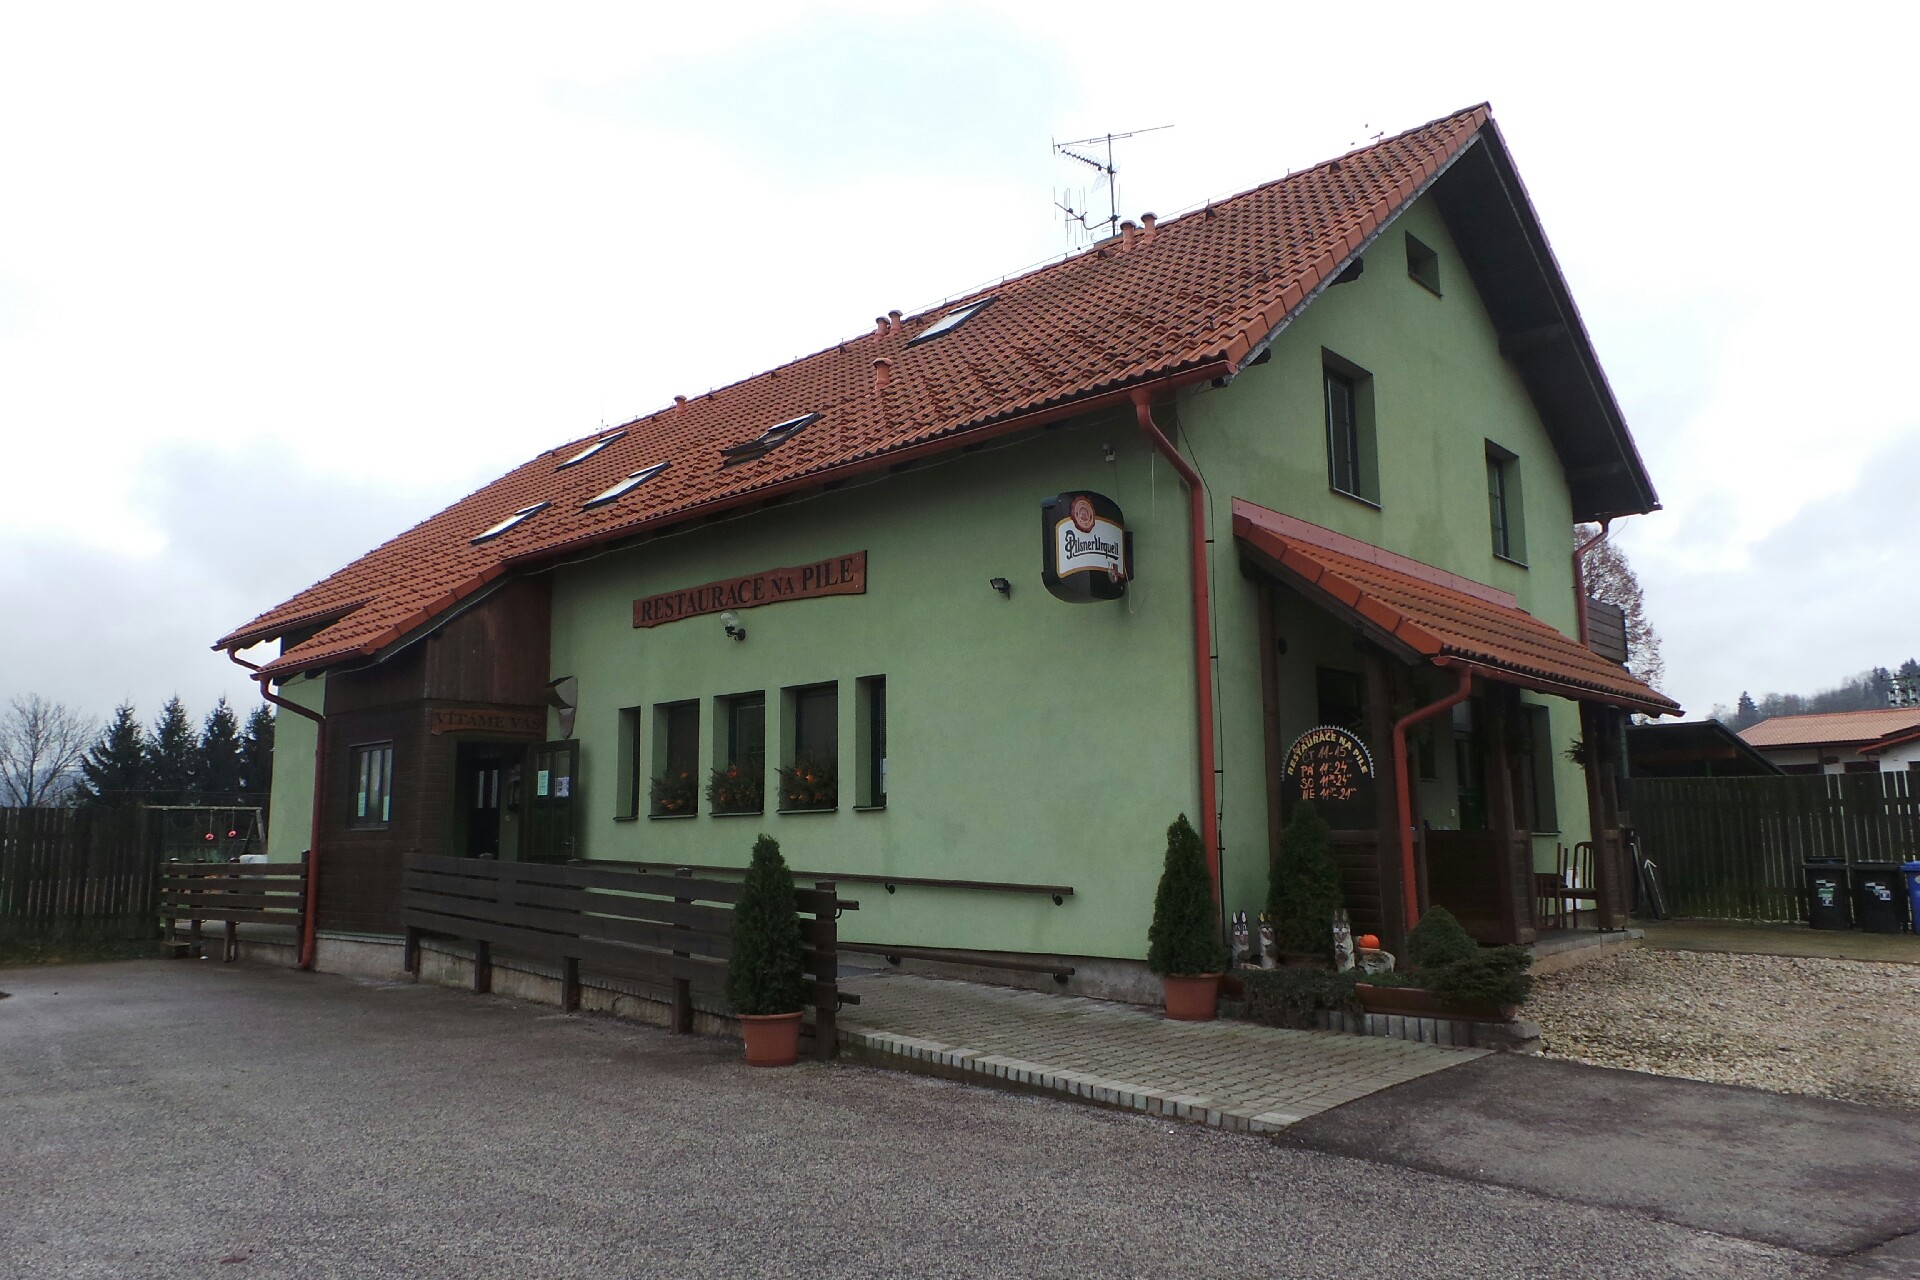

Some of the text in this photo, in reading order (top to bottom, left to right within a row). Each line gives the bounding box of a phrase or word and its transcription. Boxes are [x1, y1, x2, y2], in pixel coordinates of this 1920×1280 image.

[1065, 530, 1119, 559] Pilsner Urquell
[640, 557, 855, 622] RESTAURACE NA PILE
[1287, 732, 1369, 776] RESTAURACE NA PILE
